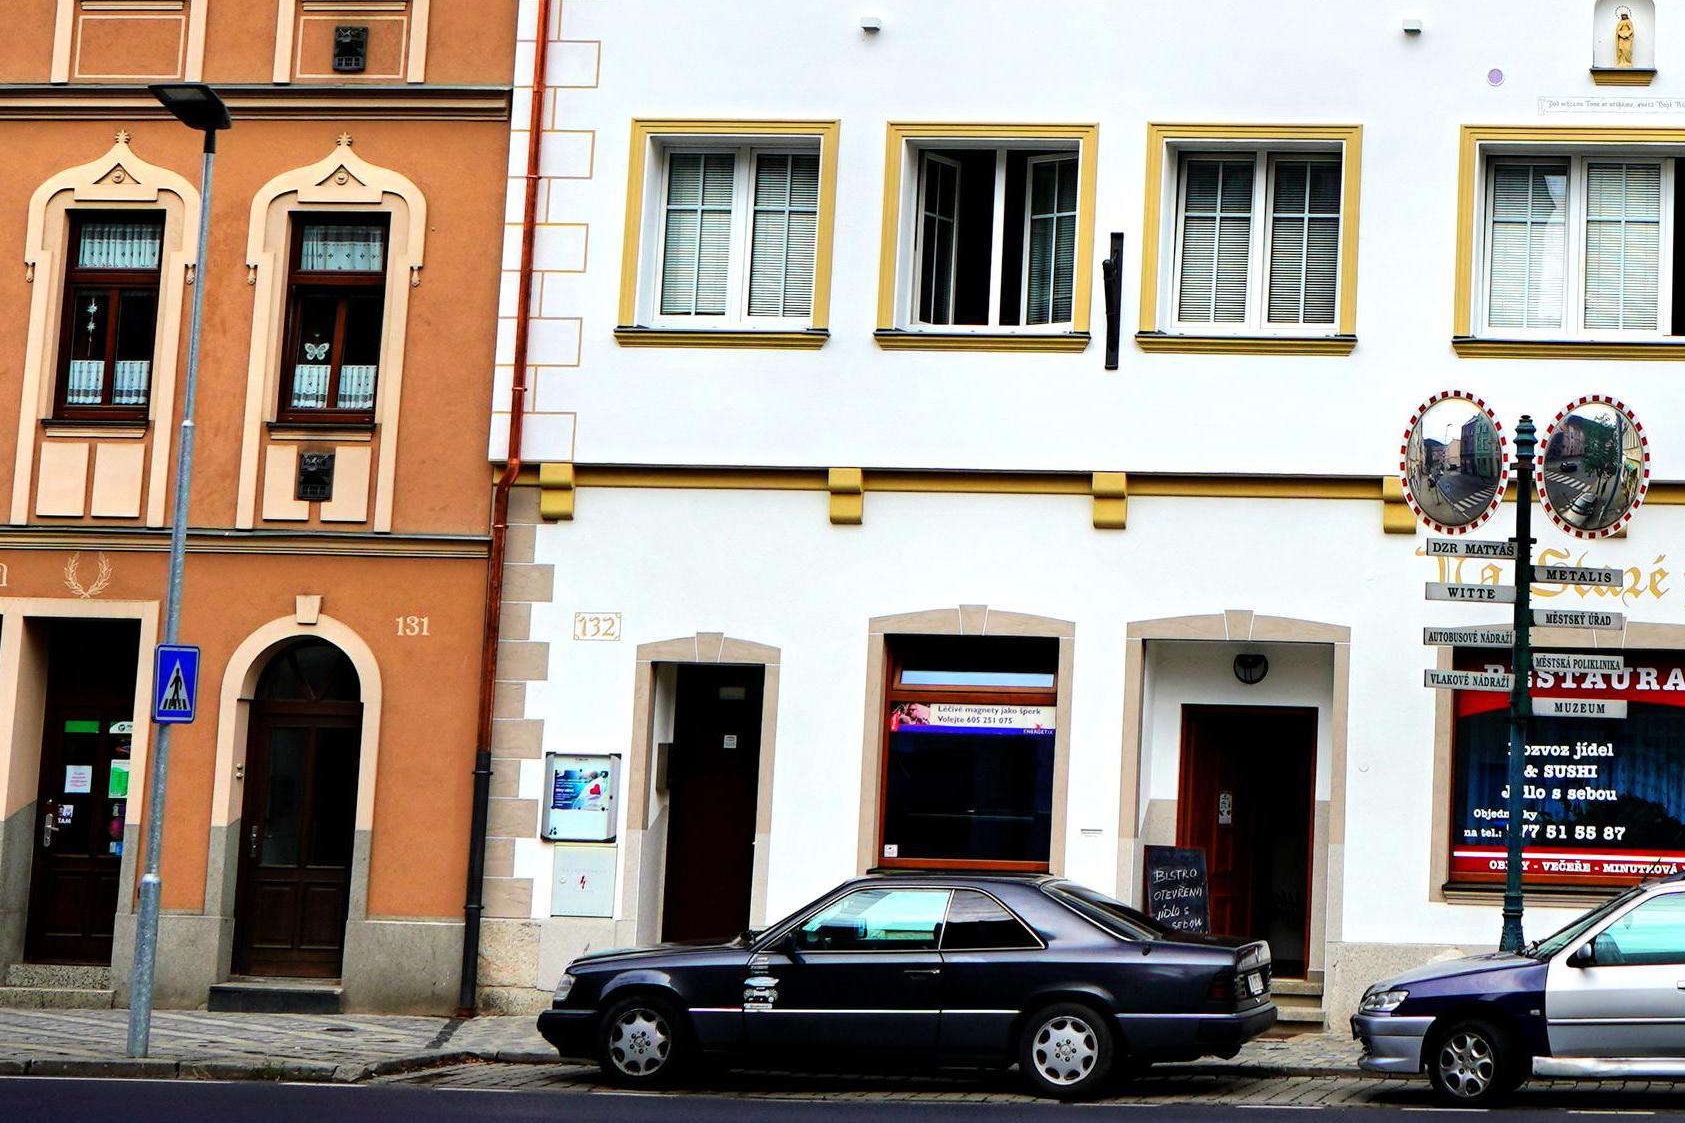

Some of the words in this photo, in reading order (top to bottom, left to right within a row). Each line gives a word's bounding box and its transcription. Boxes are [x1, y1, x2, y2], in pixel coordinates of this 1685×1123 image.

[1433, 543, 1458, 553] DZR
[1465, 542, 1514, 556] MATYÁŠ
[1546, 569, 1612, 583] METALIS
[1448, 587, 1496, 599] WITTE
[1545, 612, 1586, 625] MĚSTSKÝ
[1588, 612, 1611, 625] ÚŘAD
[395, 616, 430, 636] 131
[578, 616, 616, 638] 132
[1428, 630, 1478, 643] AUTOBUSOVÉ
[1480, 631, 1513, 644] NÁDRAŽÍ
[1536, 655, 1571, 669] MĚSTSKÁ
[1573, 659, 1621, 670] POLIKLINIKA
[1430, 673, 1470, 686] VLAKOVÉ
[1472, 674, 1510, 688] NÁDRAŽÍ
[965, 707, 998, 715] magnety
[1001, 706, 1017, 715] jako
[1554, 702, 1605, 714] MUZEUM
[938, 716, 965, 724] Volejte
[1508, 742, 1569, 756] ozvoz
[1573, 742, 1614, 760] jídel
[1524, 764, 1538, 778] &
[1544, 765, 1597, 778] SUSHI
[1501, 785, 1546, 799] Jlo
[1552, 786, 1561, 799] s
[1567, 786, 1617, 801] sebou
[1473, 809, 1538, 821] Objednky
[1464, 829, 1477, 837] na
[1481, 828, 1502, 837] tel.:
[1507, 824, 1540, 838] 77
[1546, 825, 1567, 839] 51
[1575, 826, 1596, 840] 55
[1603, 826, 1625, 840] 87
[1489, 860, 1530, 871] OBY
[1542, 860, 1591, 873] VEČEŘE
[1603, 862, 1678, 874] MINUTKOVÁ
[1153, 868, 1197, 884] BISTRO
